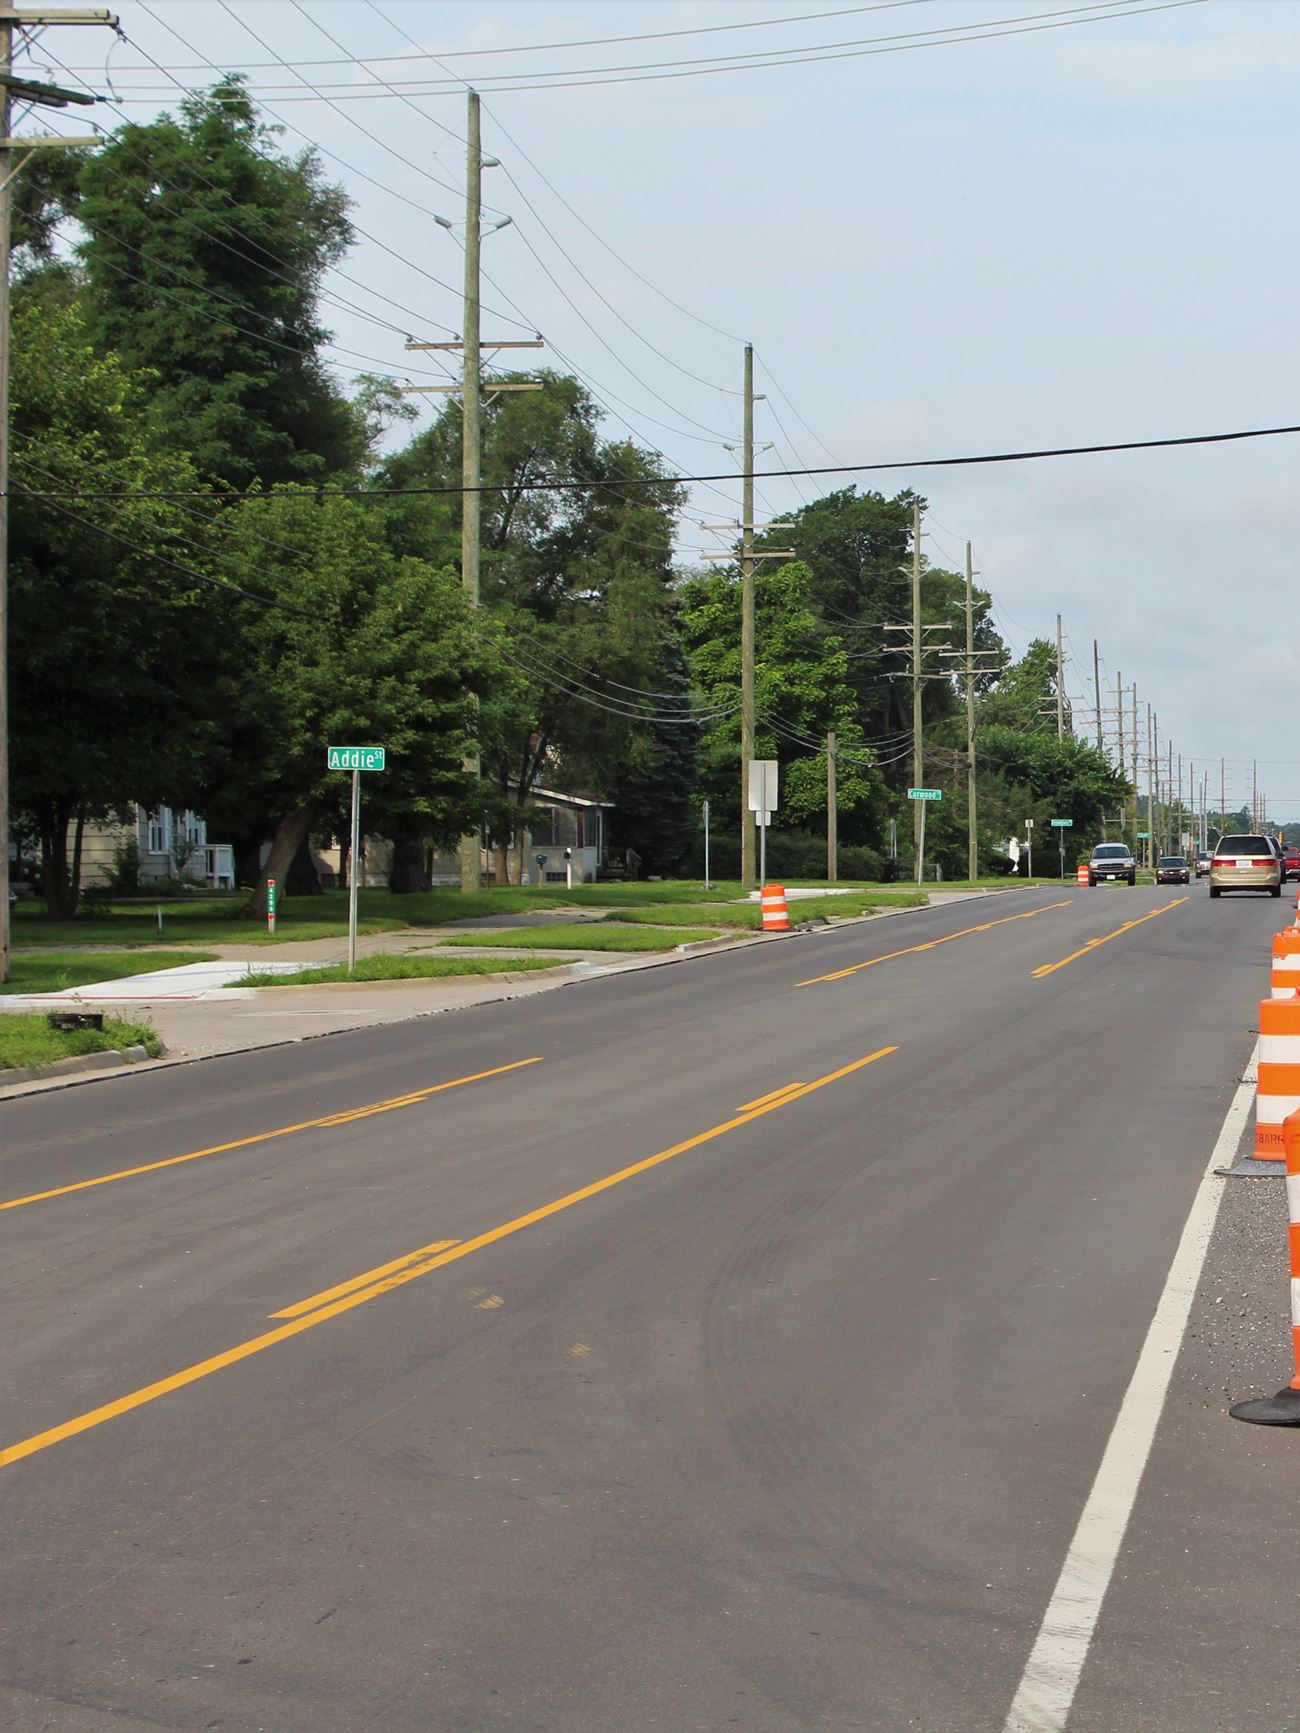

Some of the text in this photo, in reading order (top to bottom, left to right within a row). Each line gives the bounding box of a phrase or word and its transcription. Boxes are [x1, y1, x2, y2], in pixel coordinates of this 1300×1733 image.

[330, 750, 382, 768] Addie St
[1258, 1133, 1286, 1145] BARR
